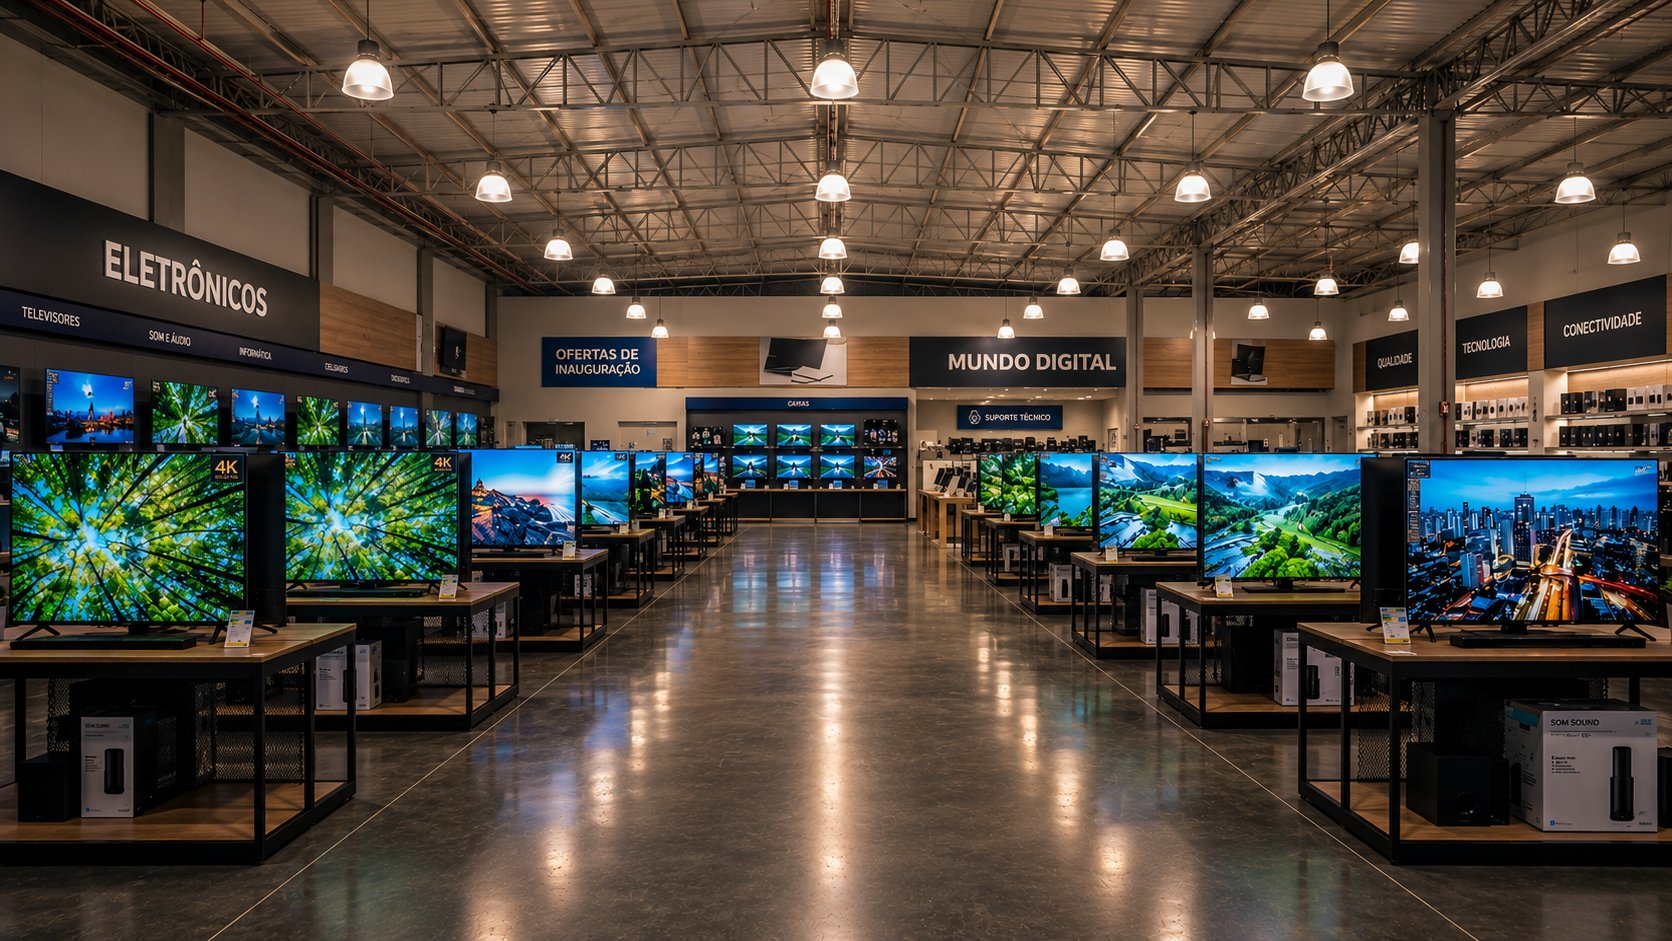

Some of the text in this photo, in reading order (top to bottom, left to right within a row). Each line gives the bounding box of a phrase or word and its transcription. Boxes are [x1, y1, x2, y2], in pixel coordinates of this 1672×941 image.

[103, 239, 268, 318] ELETRÔNICOS
[21, 305, 80, 328] TELEVISORES
[1562, 311, 1643, 338] CONECTIVIDADE
[148, 329, 191, 347] SOM E ÁUDIO
[1462, 335, 1511, 354] TECNOLOGIA
[555, 348, 639, 360] OFERTAS DE
[948, 353, 1117, 371] MUNDO DIGITAL
[1377, 352, 1413, 369] QUALIDADE
[555, 361, 641, 377] INAUGURAÇÃO
[984, 411, 1051, 422] SUPORTE TÉCNICO
[214, 459, 238, 475] 4K
[434, 456, 452, 468] 4K
[1550, 718, 1600, 727] SOM SOUND
